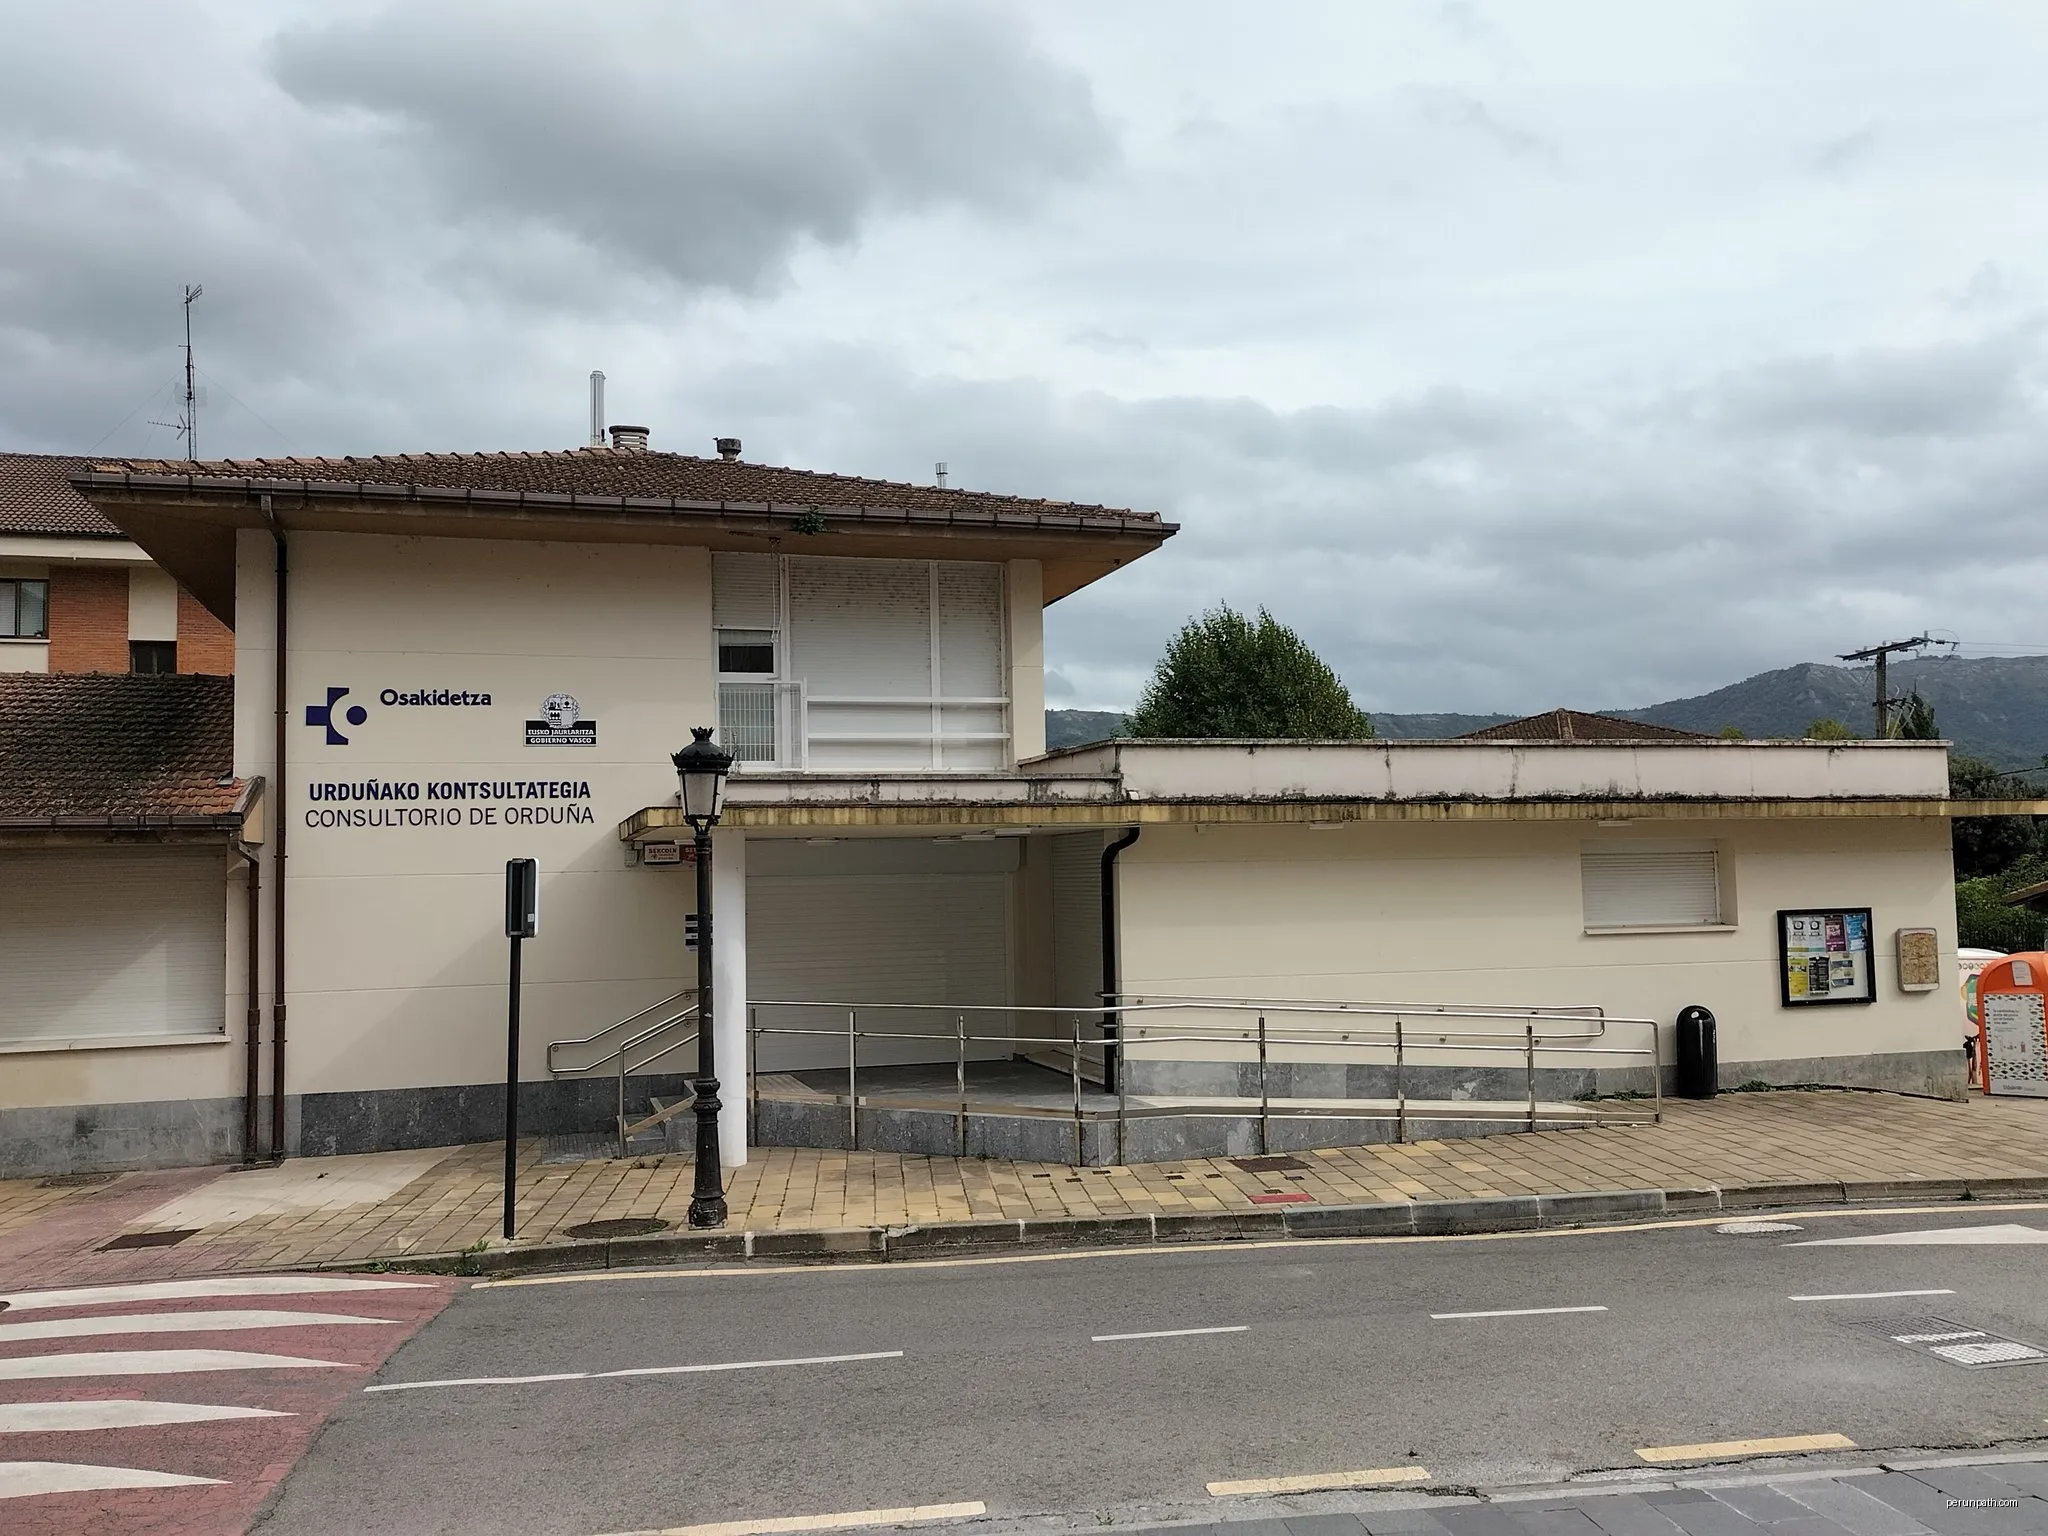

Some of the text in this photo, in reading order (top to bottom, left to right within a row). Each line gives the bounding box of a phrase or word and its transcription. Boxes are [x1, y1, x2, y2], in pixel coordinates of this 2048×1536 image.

[380, 688, 492, 706] Osakidetza
[309, 778, 591, 801] URDUÑAKO KONTSULTATEGIA
[305, 803, 595, 827] CONSULTORIO DE ORDUÑA
